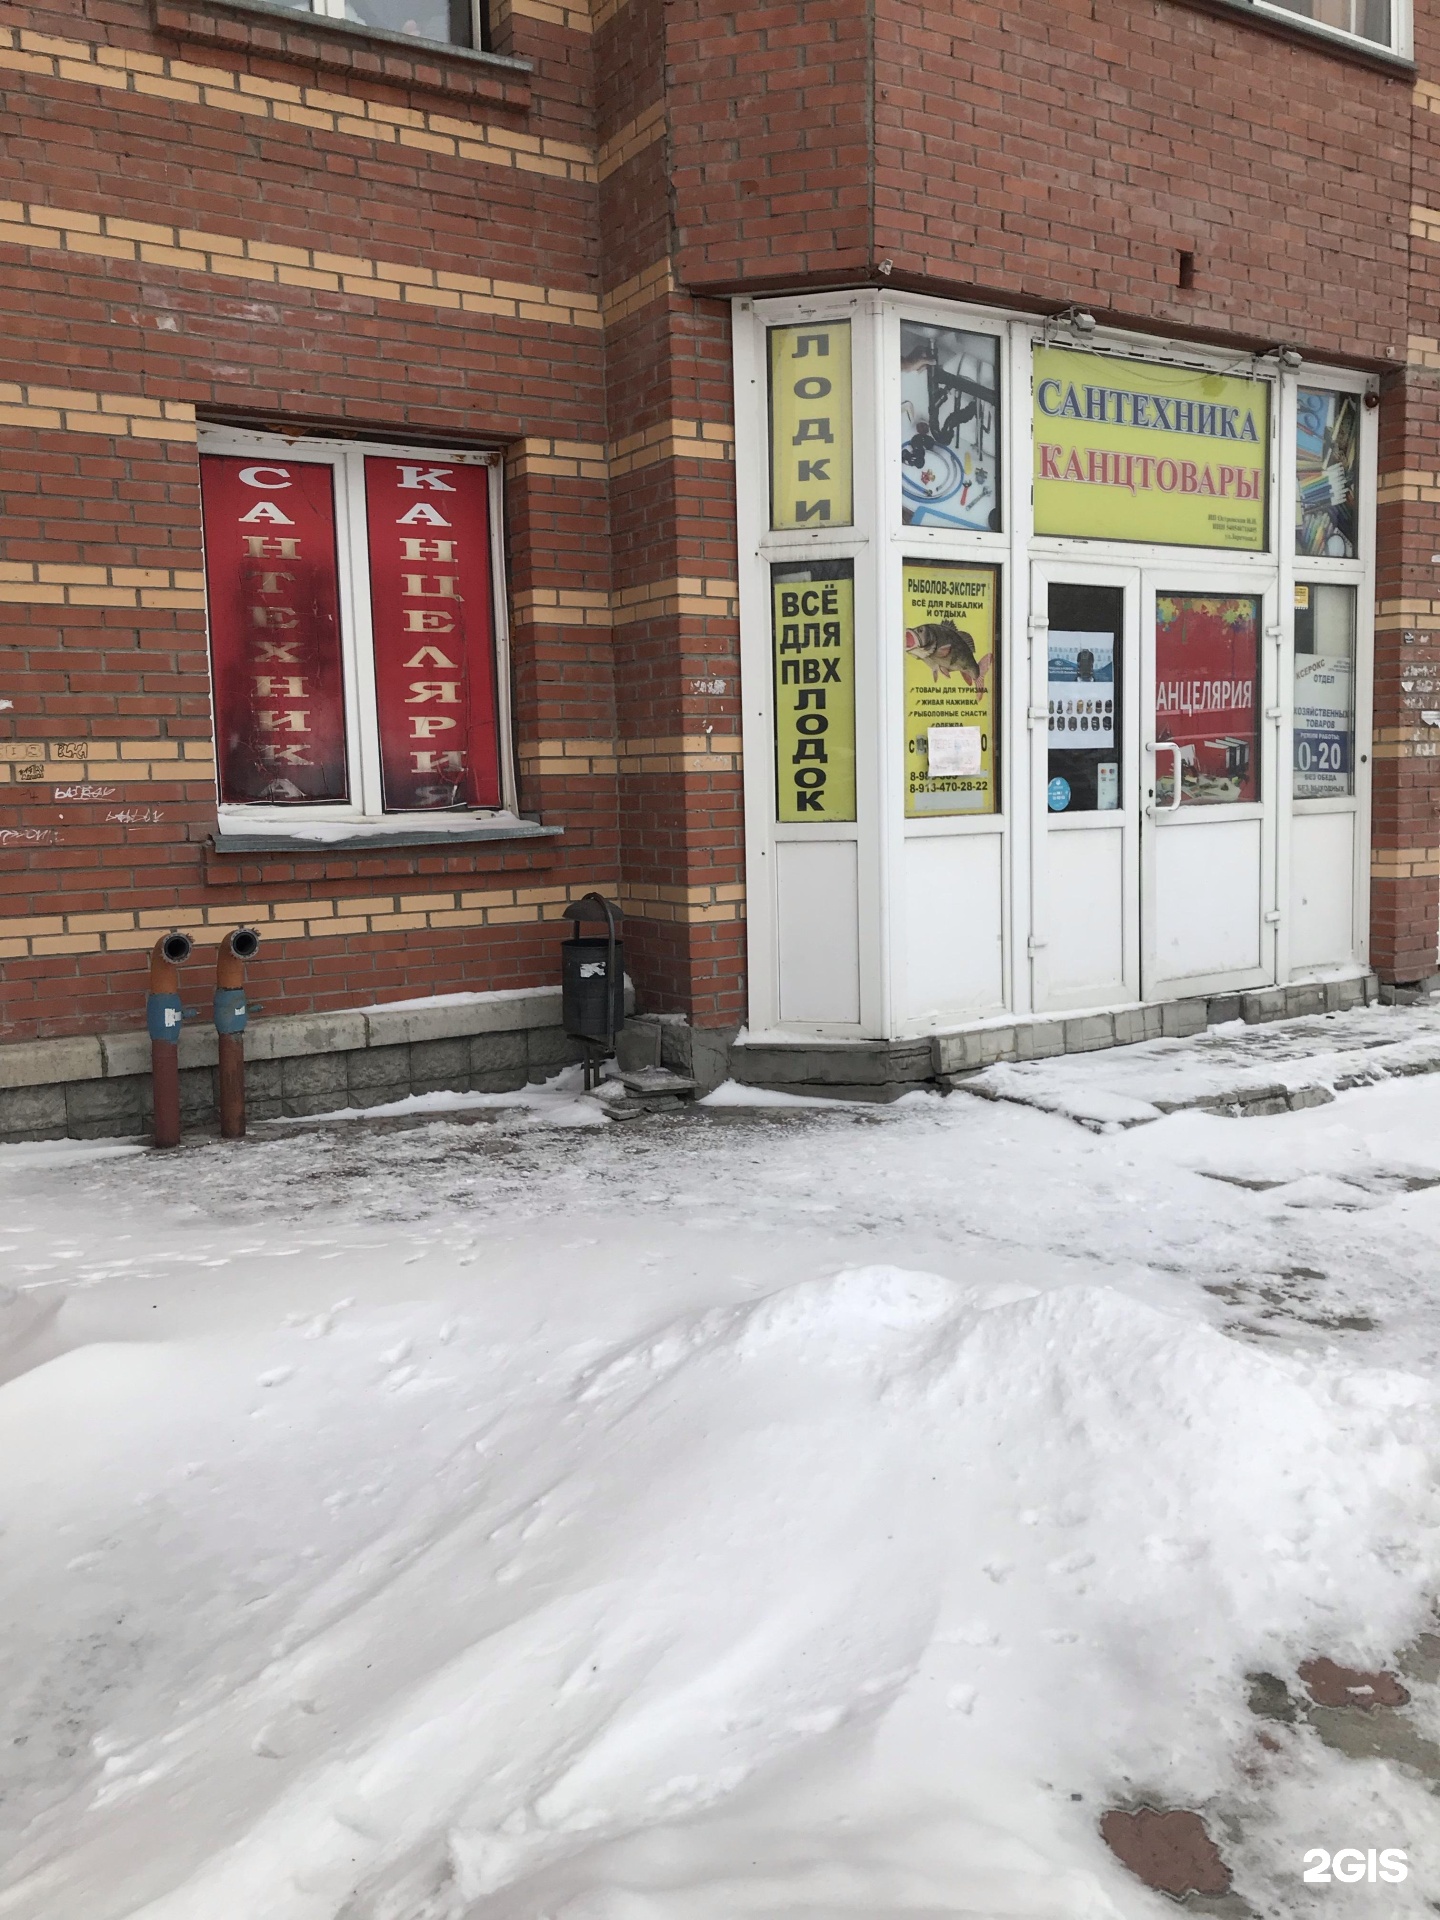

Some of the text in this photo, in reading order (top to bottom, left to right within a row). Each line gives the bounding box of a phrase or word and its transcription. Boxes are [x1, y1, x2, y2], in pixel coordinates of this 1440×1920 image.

[1037, 378, 1260, 443] САНТЕХНИКА
[791, 334, 834, 522] ЛОДКИ
[1038, 443, 1262, 501] КАНЦТОВАРЫ
[907, 578, 986, 597] РЫБОЛОВ-ЭКСПЕРТ
[781, 584, 839, 618] ВСЁ
[912, 598, 983, 609] ВСЁ ДЛЯ РЫБАЛКИ
[926, 609, 967, 618] И ОТДЫХА
[238, 466, 315, 798] САНТЕХНИКА
[780, 621, 841, 655] ДЛЯ
[781, 657, 841, 685] ПВХ
[1295, 658, 1326, 680] КСЕРОКС
[1313, 674, 1335, 684] ОТДЕЛ
[915, 686, 941, 694] ТОВАРЫ
[958, 686, 989, 694] ТУРИЗМА
[1156, 680, 1252, 717] АНЦЕЛЯРИЯ
[1306, 718, 1336, 729] ТОВАРОВ
[792, 688, 829, 813] ЛОДОК
[1294, 741, 1342, 771] 0-20
[909, 781, 989, 794] 8-913-470-28-22
[1297, 784, 1309, 792] БЕЗ
[1304, 773, 1337, 781] БЕЗ ОБЕДА
